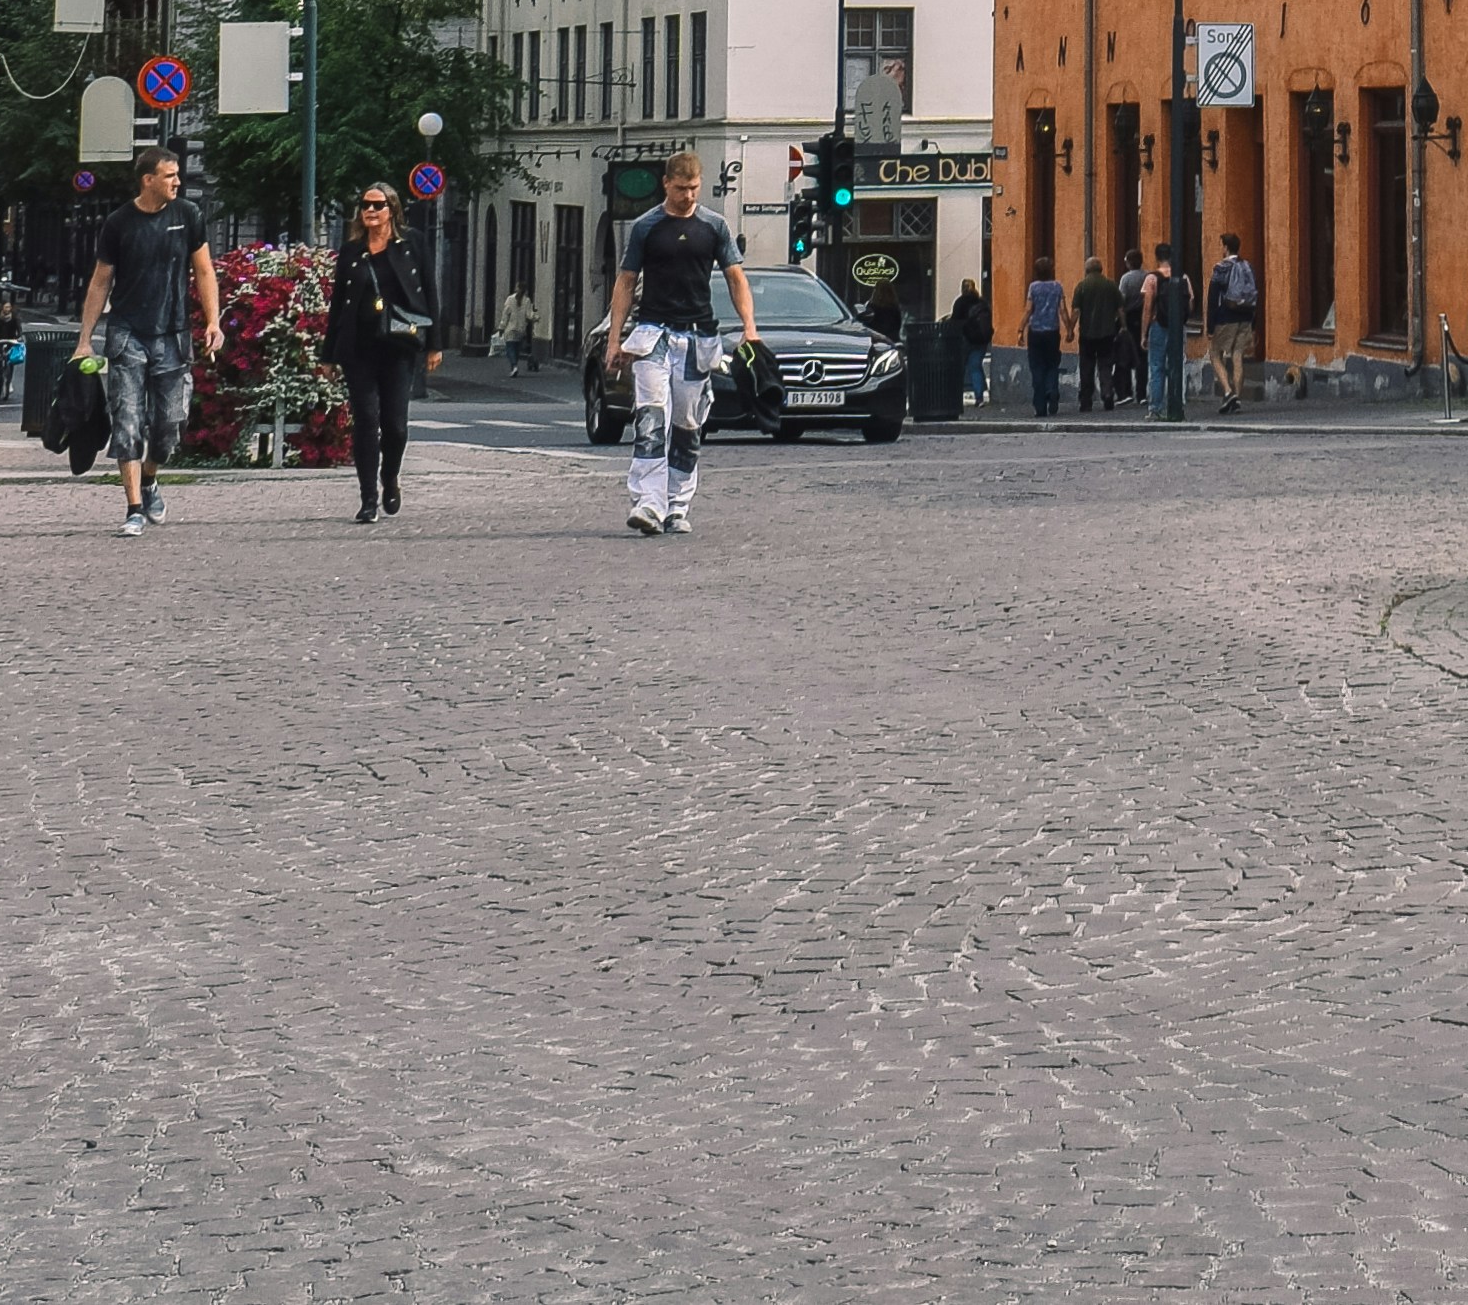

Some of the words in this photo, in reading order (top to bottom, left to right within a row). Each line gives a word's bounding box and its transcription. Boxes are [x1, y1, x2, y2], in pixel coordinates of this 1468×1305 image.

[879, 159, 931, 183] The
[792, 393, 805, 403] BT
[810, 393, 842, 403] 75198
